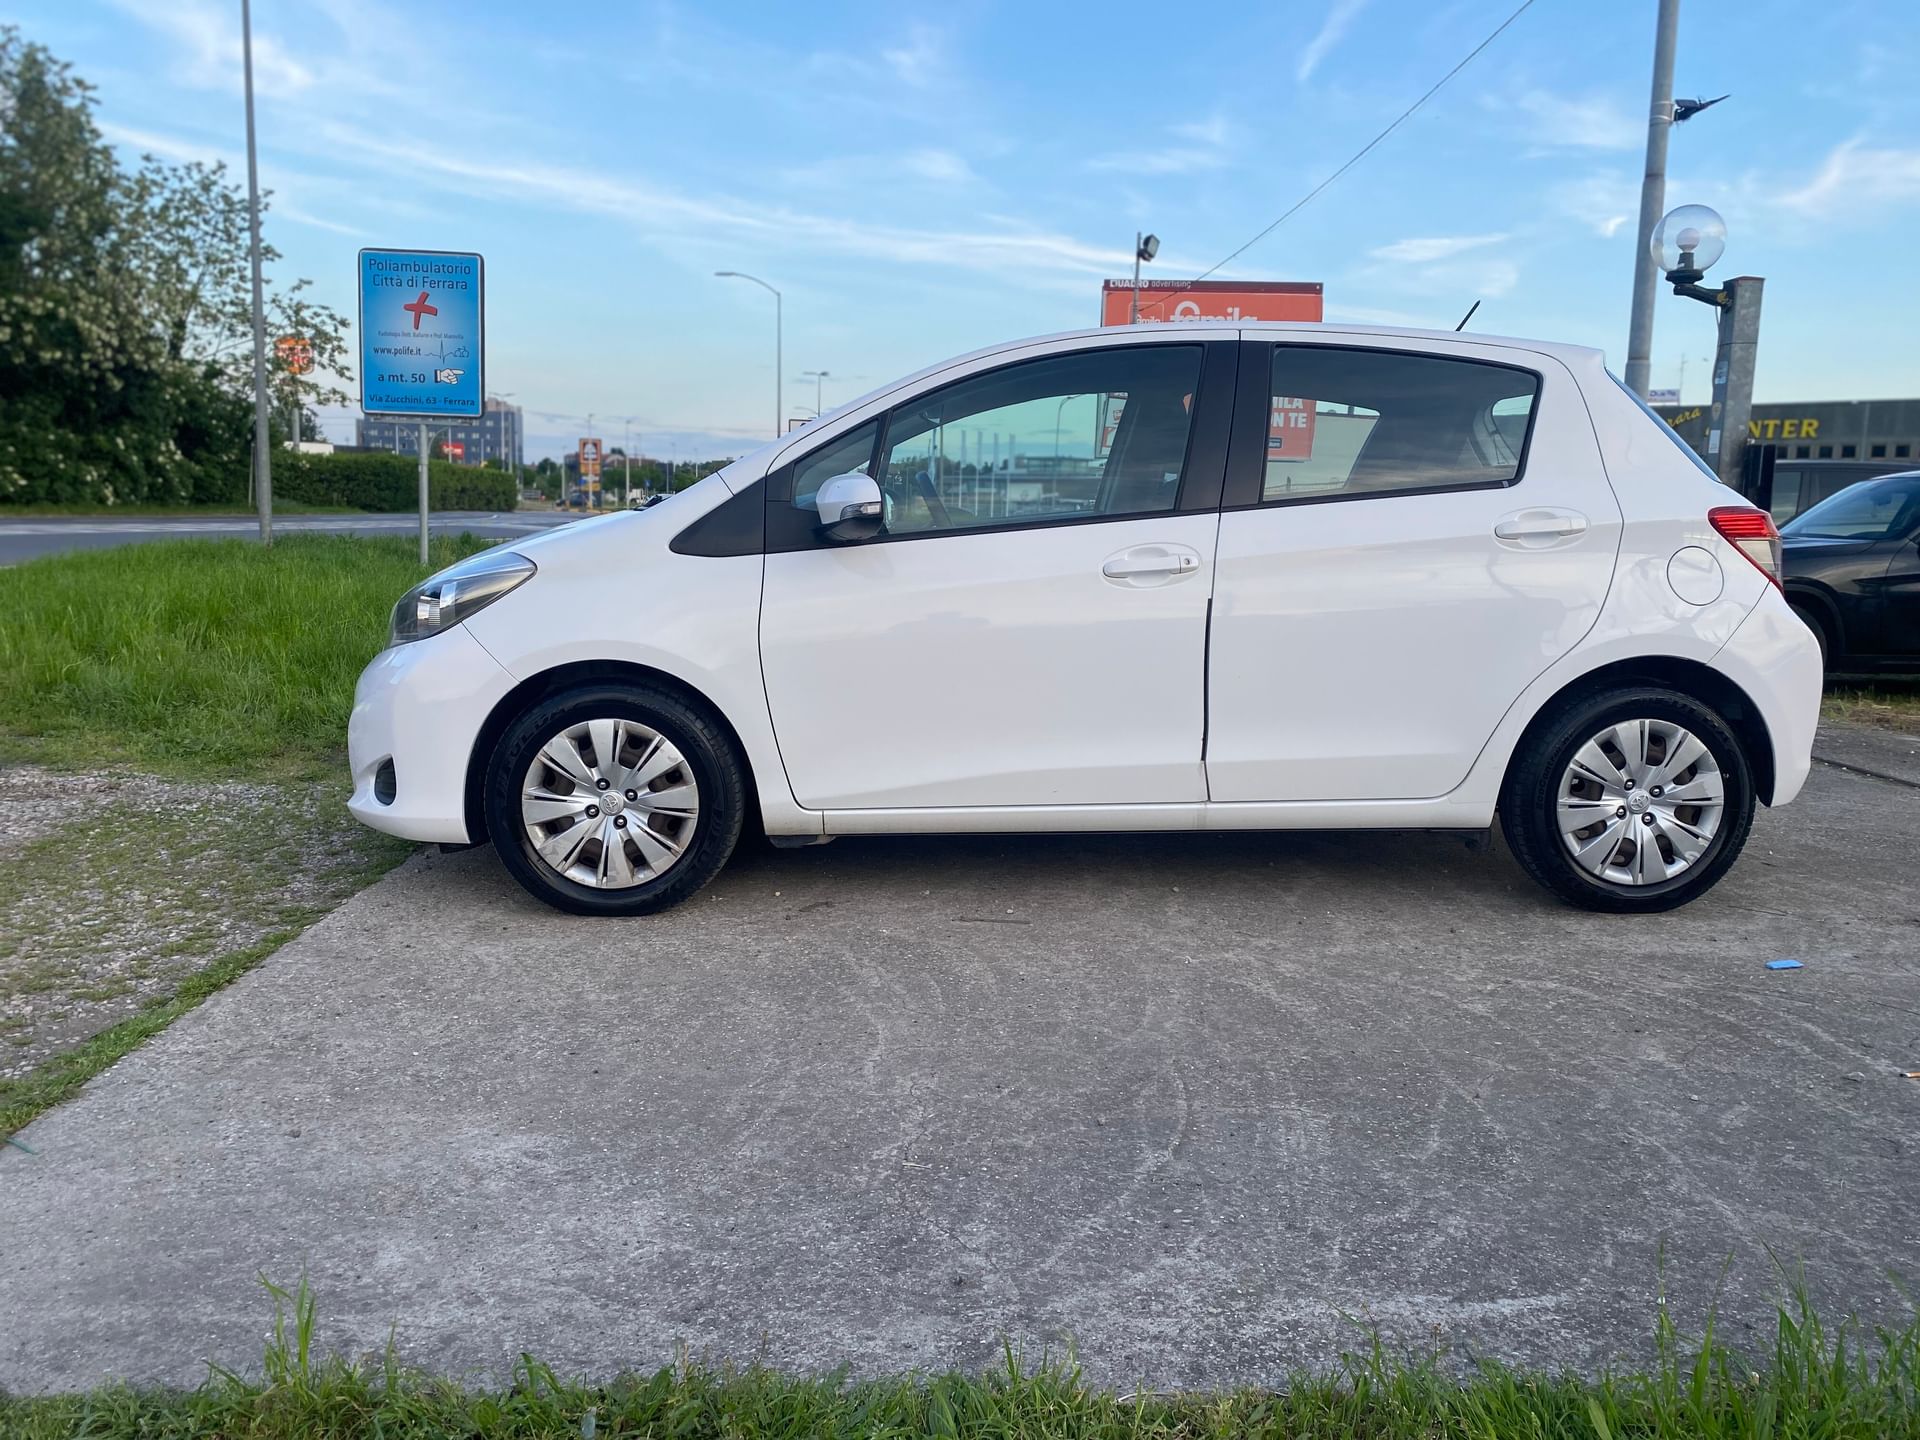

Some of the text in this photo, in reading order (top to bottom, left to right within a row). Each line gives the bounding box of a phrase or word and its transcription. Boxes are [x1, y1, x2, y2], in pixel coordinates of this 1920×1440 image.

[369, 258, 471, 275] Poliambulatorio
[373, 274, 468, 290] Città di Ferrara
[373, 346, 421, 356] www.polife.it
[378, 373, 426, 384] a mt. 50
[369, 394, 383, 403] Via
[426, 397, 437, 405] 63
[443, 397, 475, 407] Ferrara
[1289, 412, 1307, 428] TE
[1748, 419, 1820, 439] NTER
